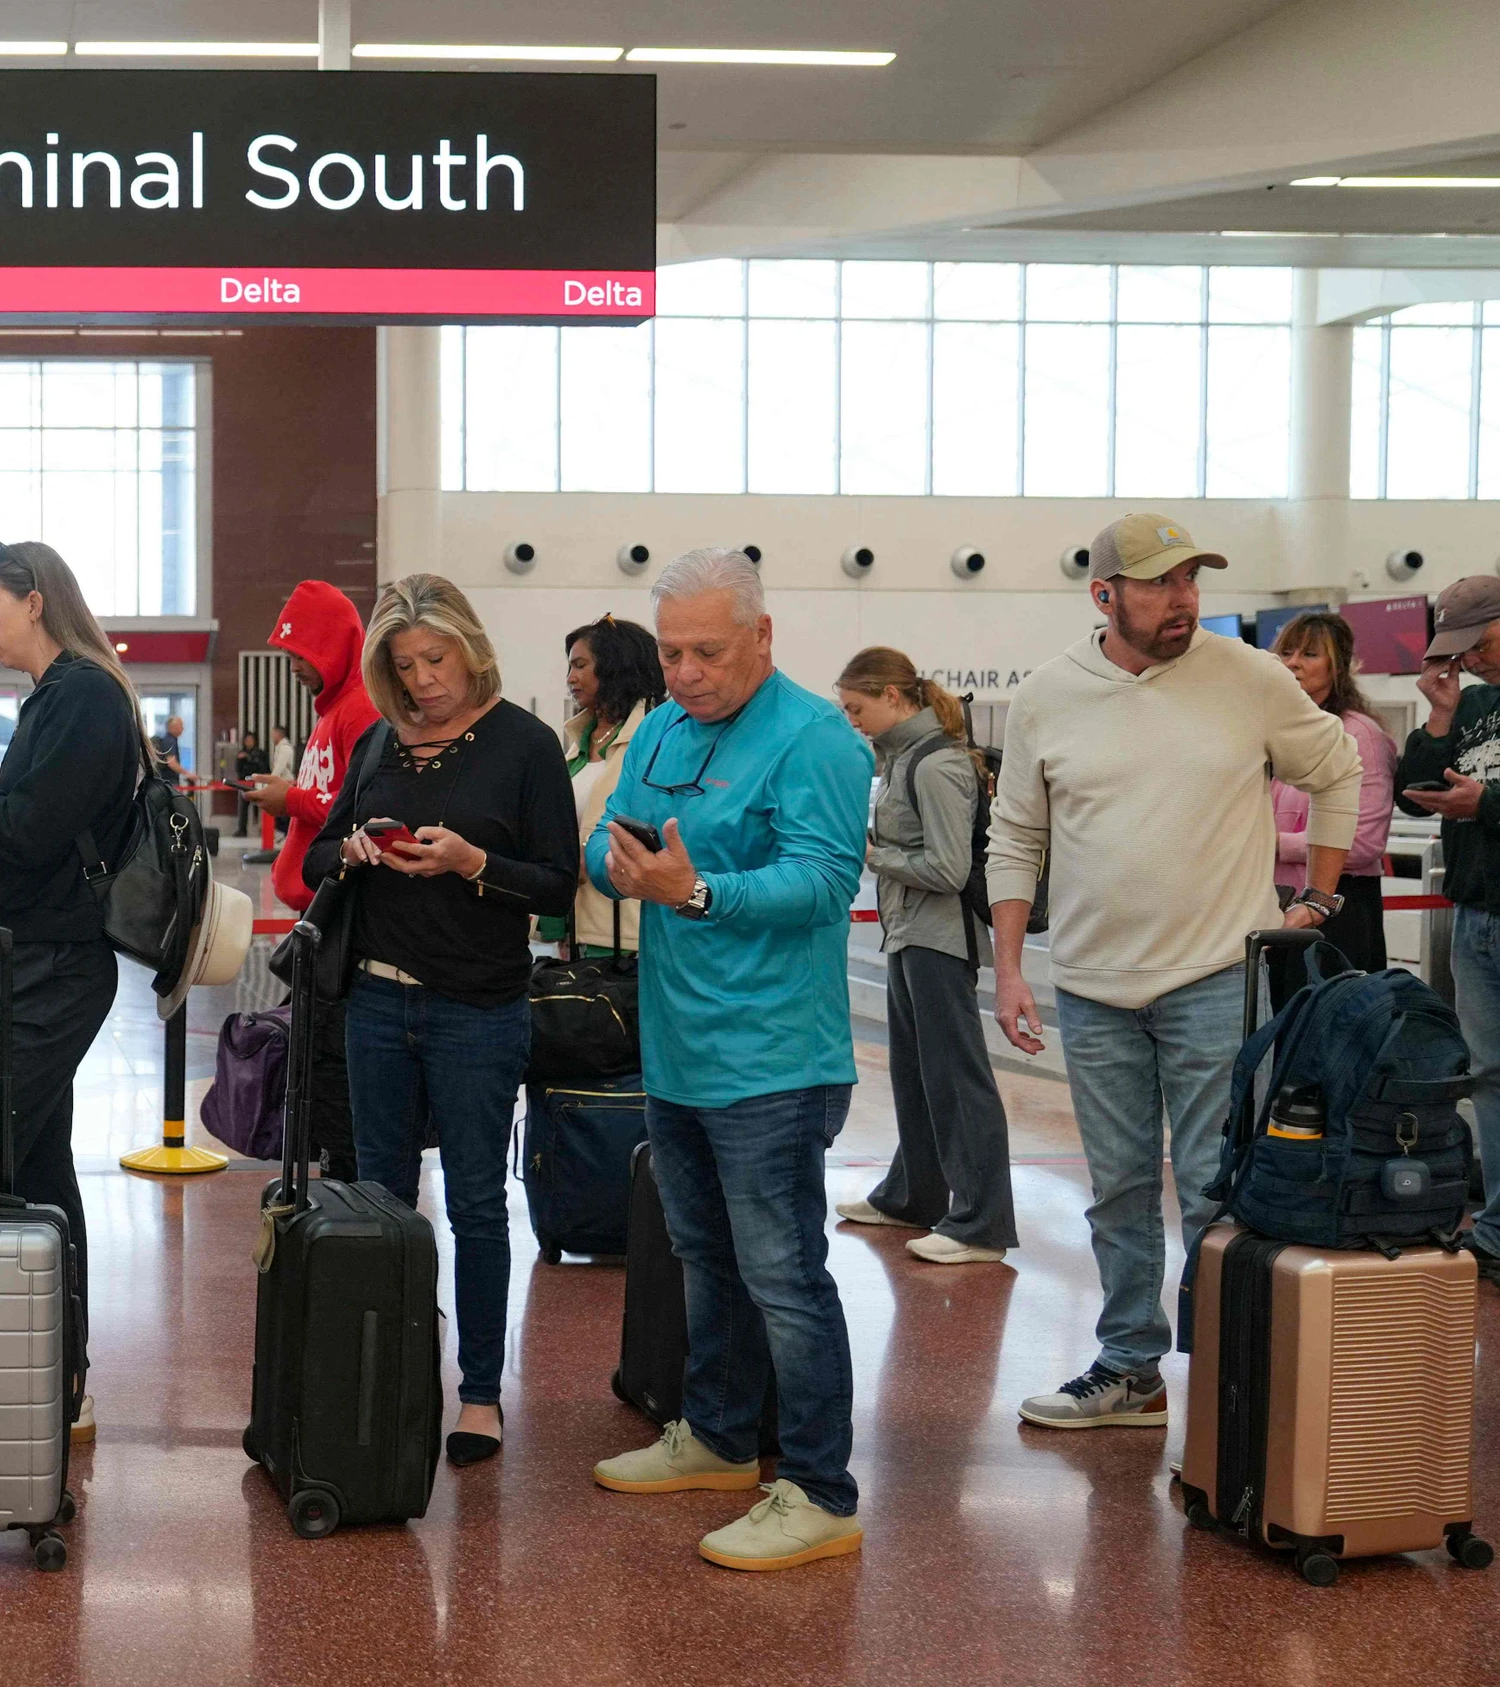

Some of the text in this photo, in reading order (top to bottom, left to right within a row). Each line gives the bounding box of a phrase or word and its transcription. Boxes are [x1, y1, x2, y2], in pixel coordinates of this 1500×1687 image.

[246, 134, 524, 211] South
[221, 278, 300, 303] Delta
[565, 280, 641, 306] Delta
